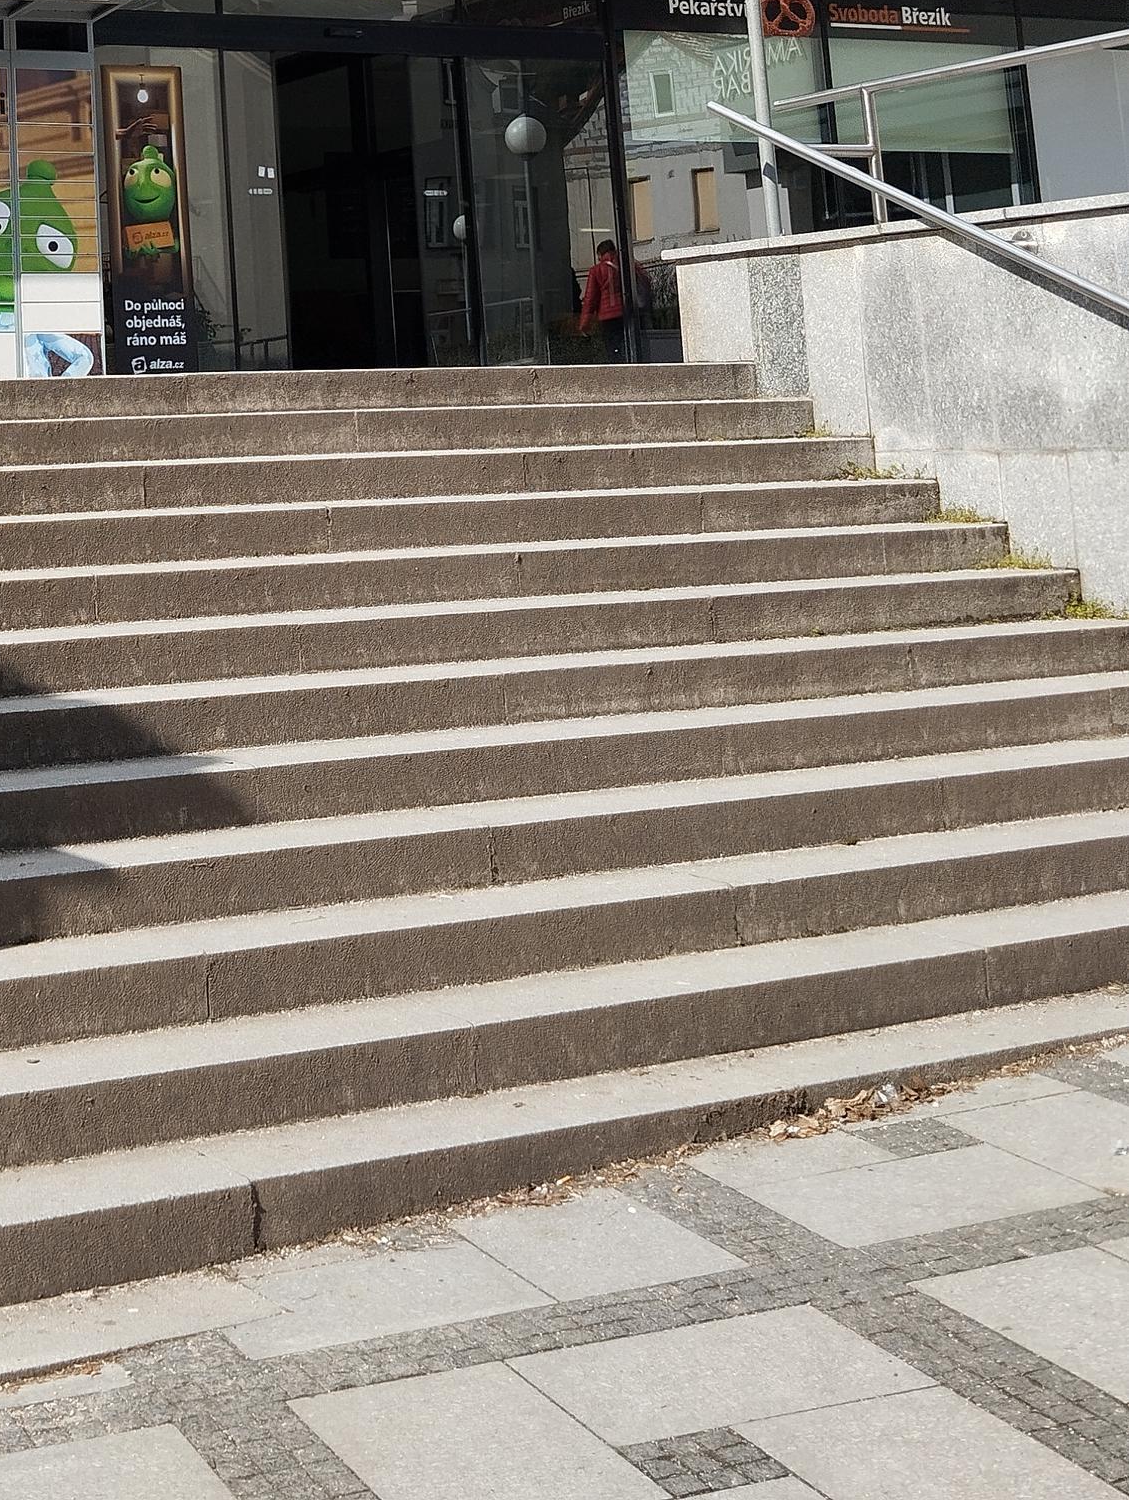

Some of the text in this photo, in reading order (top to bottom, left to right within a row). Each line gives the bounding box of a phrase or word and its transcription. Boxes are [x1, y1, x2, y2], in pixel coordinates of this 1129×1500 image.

[828, 3, 952, 26] Svoboda Březík
[124, 299, 184, 314] Do půlnoci
[125, 315, 186, 331] objednáš,
[126, 331, 187, 346] ráno máš
[149, 358, 184, 370] alza.cz
